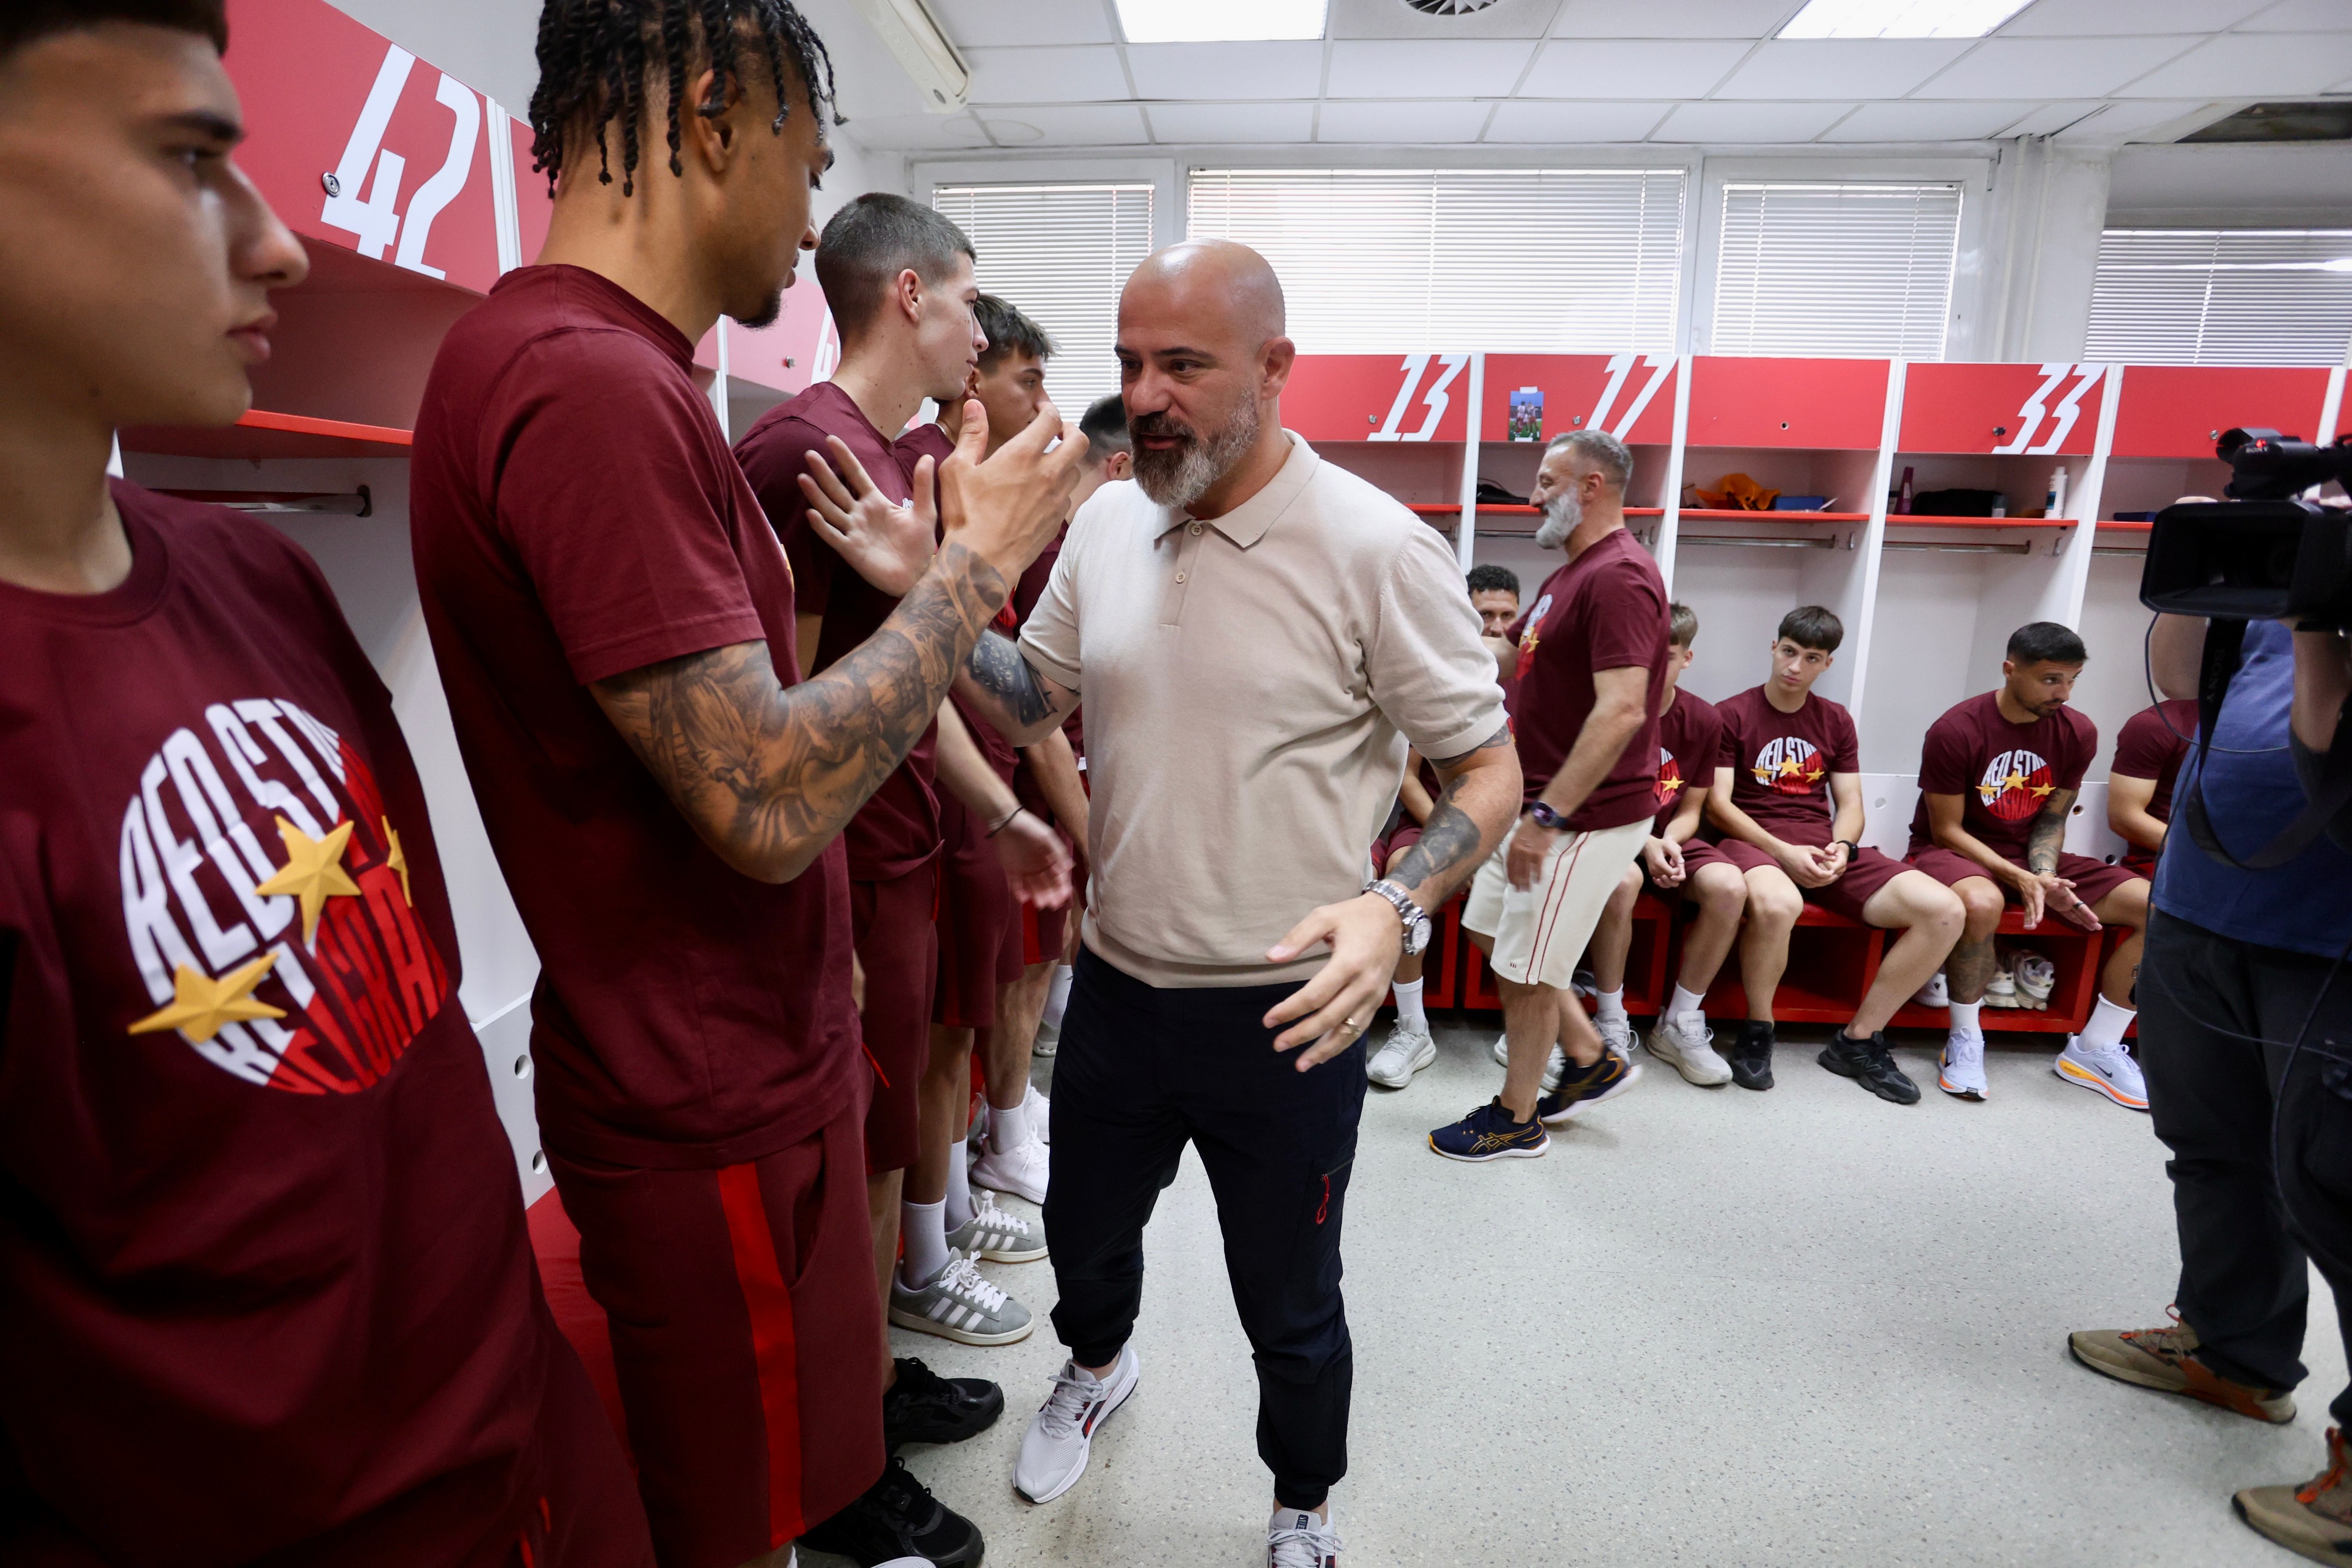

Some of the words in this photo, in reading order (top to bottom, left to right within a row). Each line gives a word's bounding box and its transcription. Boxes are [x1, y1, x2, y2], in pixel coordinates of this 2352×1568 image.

[320, 43, 480, 281] 42
[811, 303, 841, 386] 4
[1367, 355, 1470, 442] 13
[1585, 354, 1680, 443] 17
[1992, 363, 2108, 454] 33
[1755, 737, 1784, 771] RED
[1980, 750, 2012, 787] RED
[119, 727, 295, 1005] RED
